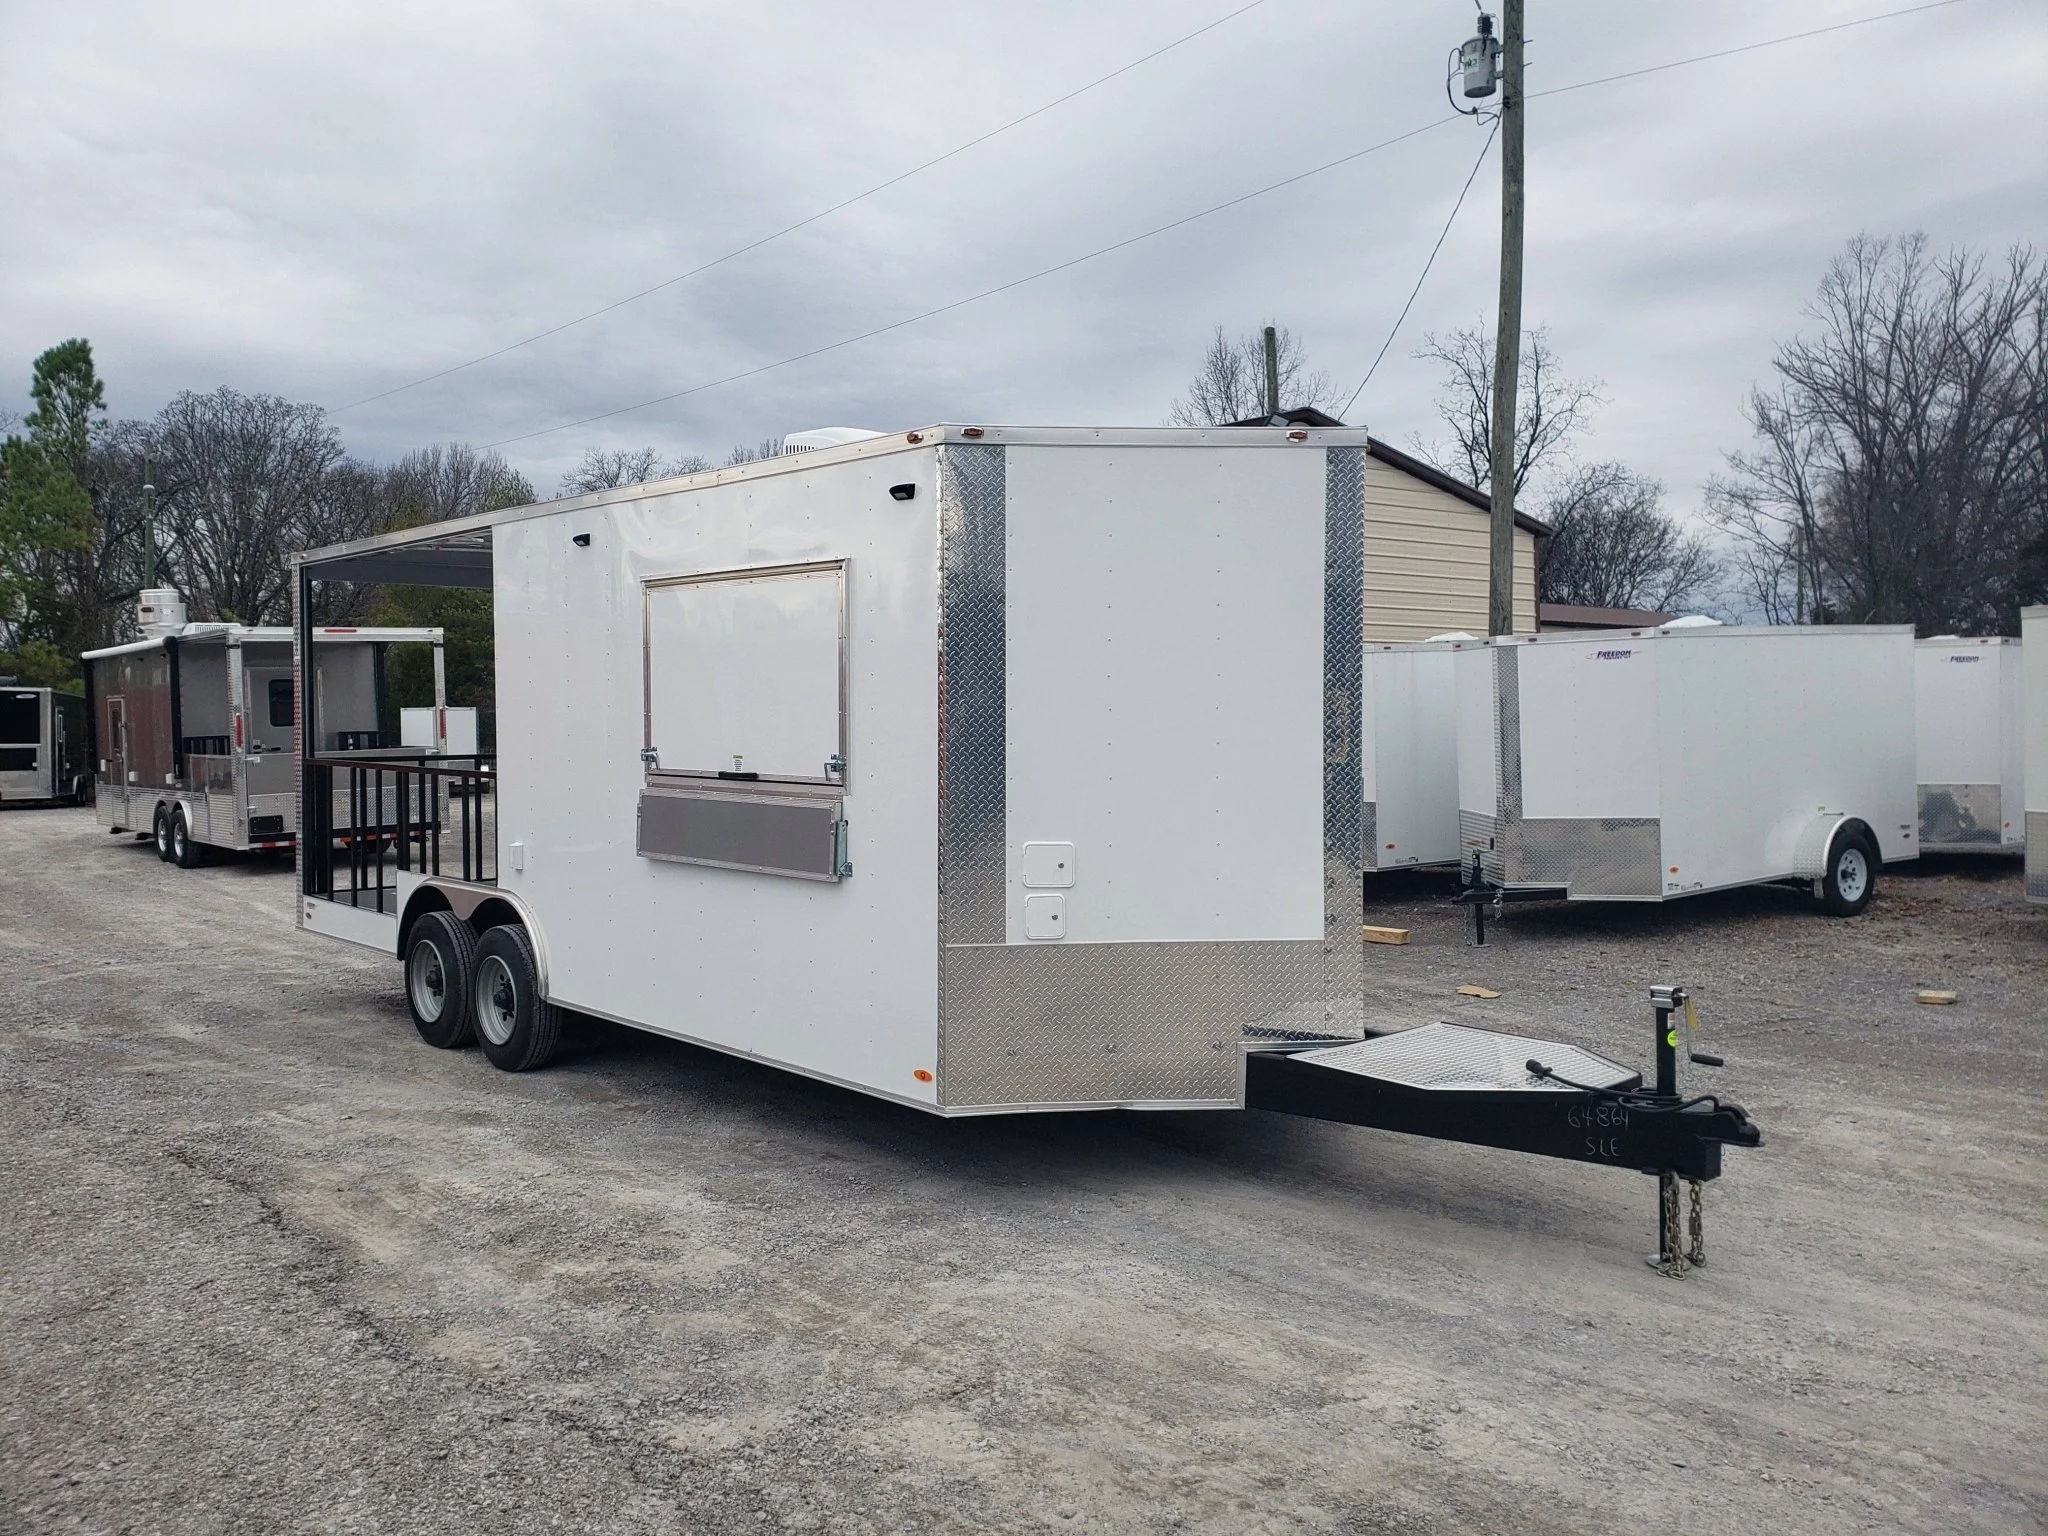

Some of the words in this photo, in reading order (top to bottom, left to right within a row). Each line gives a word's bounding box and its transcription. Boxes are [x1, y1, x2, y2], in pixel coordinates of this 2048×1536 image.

[1597, 650, 1631, 659] FREEDOM
[1567, 1105, 1629, 1131] 64864
[1585, 1136, 1621, 1157] SLE
